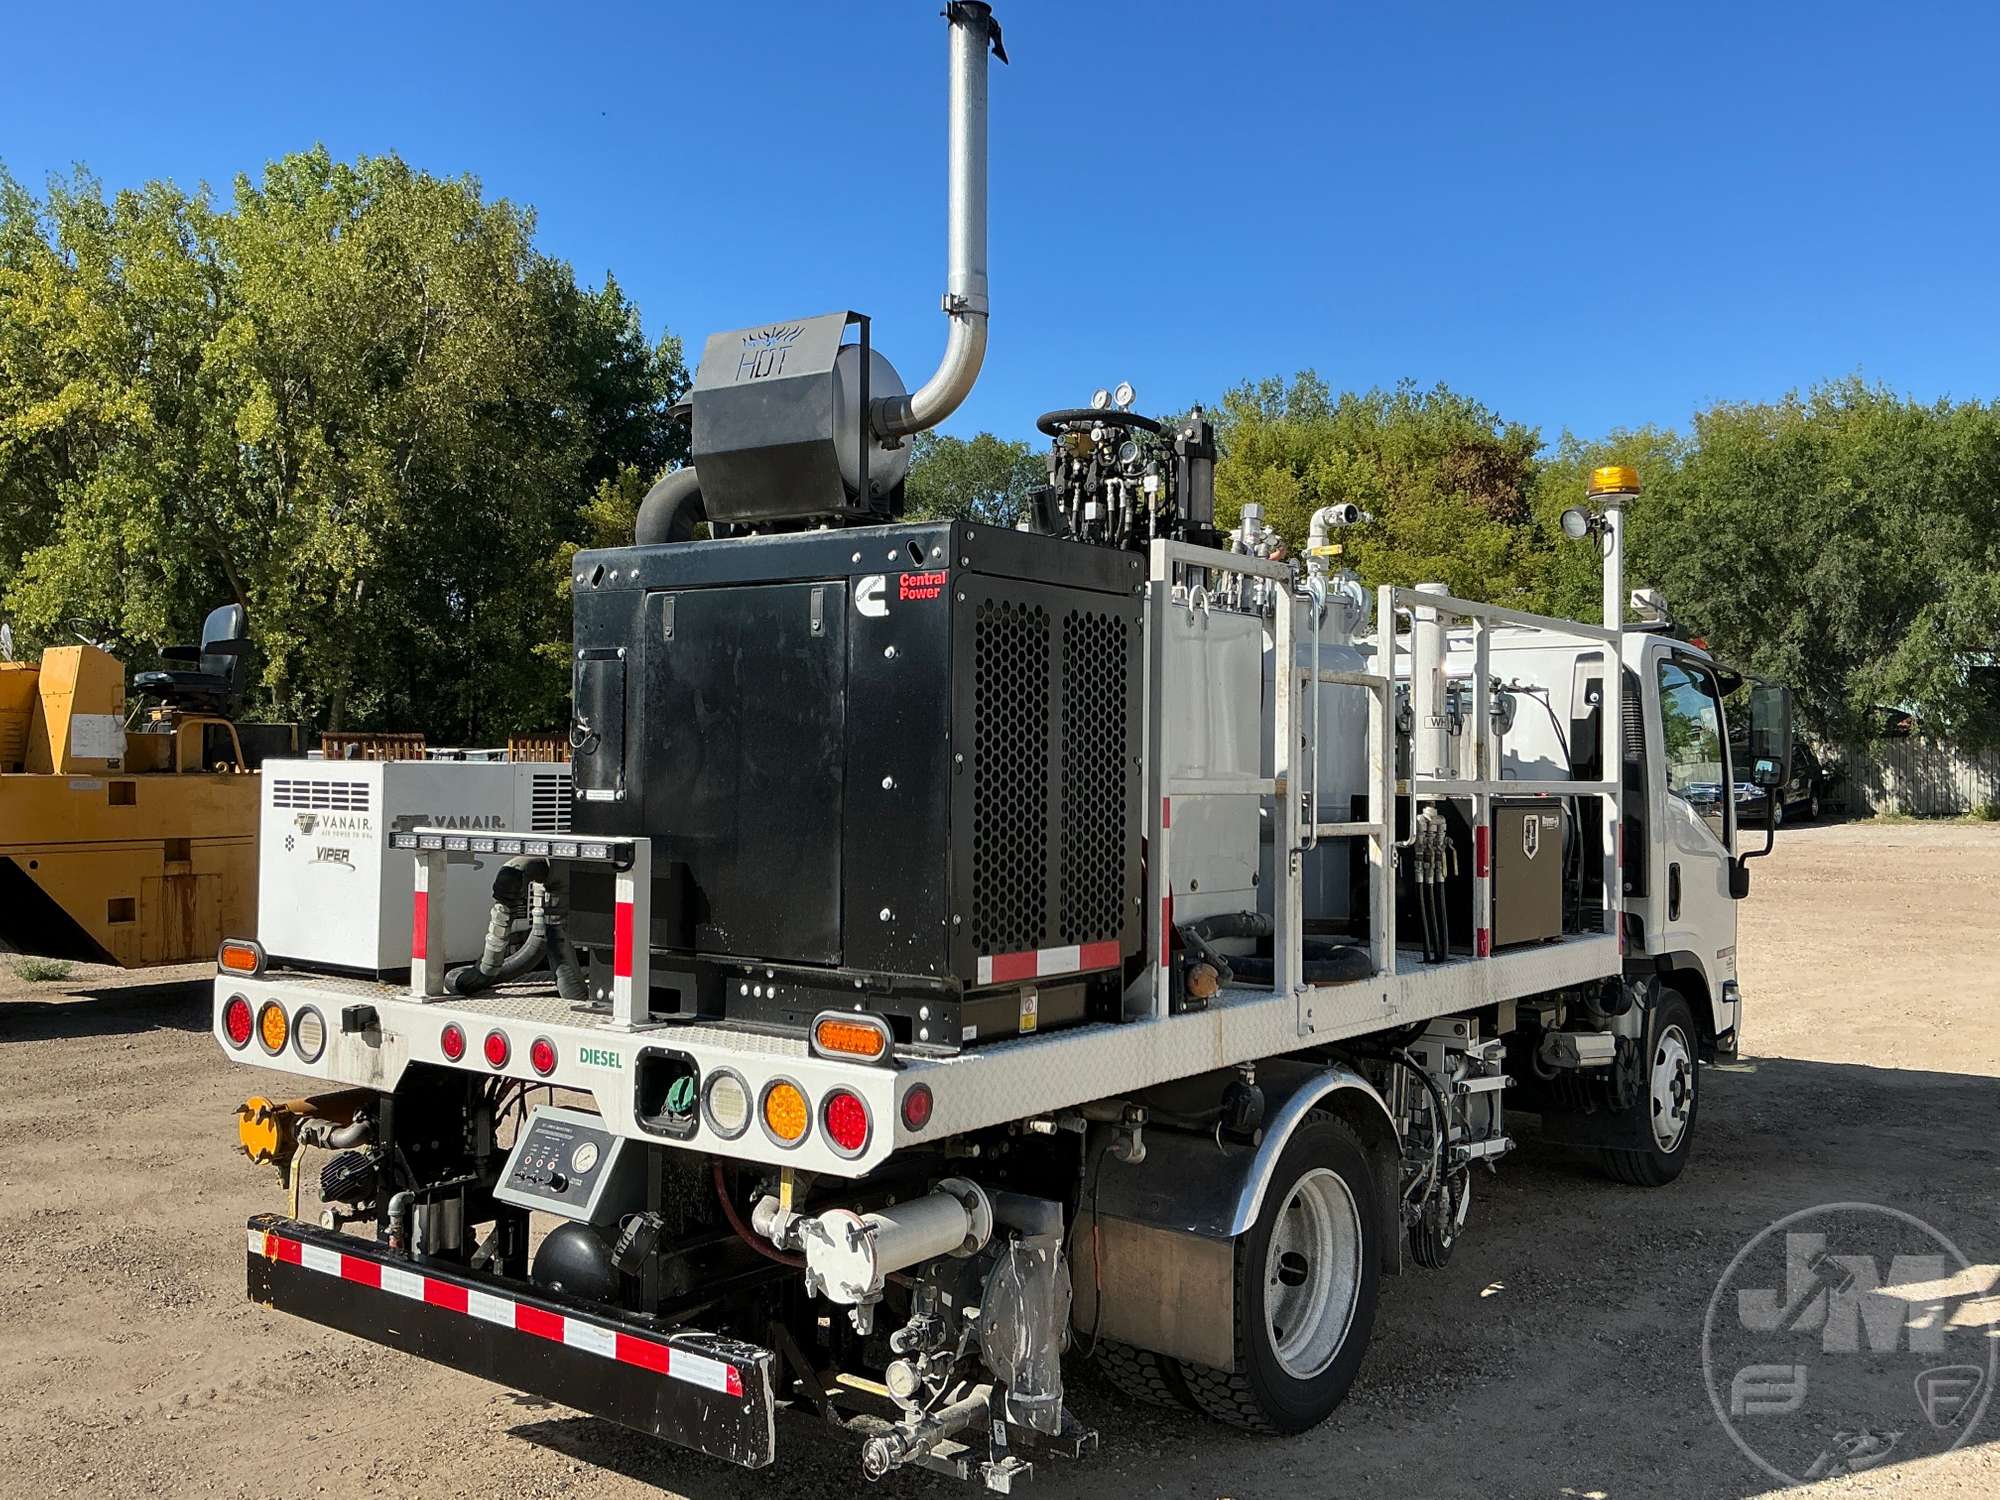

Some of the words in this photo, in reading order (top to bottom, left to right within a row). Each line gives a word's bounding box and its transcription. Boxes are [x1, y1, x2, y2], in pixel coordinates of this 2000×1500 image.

[736, 346, 792, 381] HOT
[899, 571, 946, 587] Central
[899, 587, 941, 600] Power
[322, 815, 370, 830] VANAIR
[434, 815, 502, 829] VANAIR
[316, 846, 350, 861] VIPER
[580, 1047, 622, 1069] DIESEL
